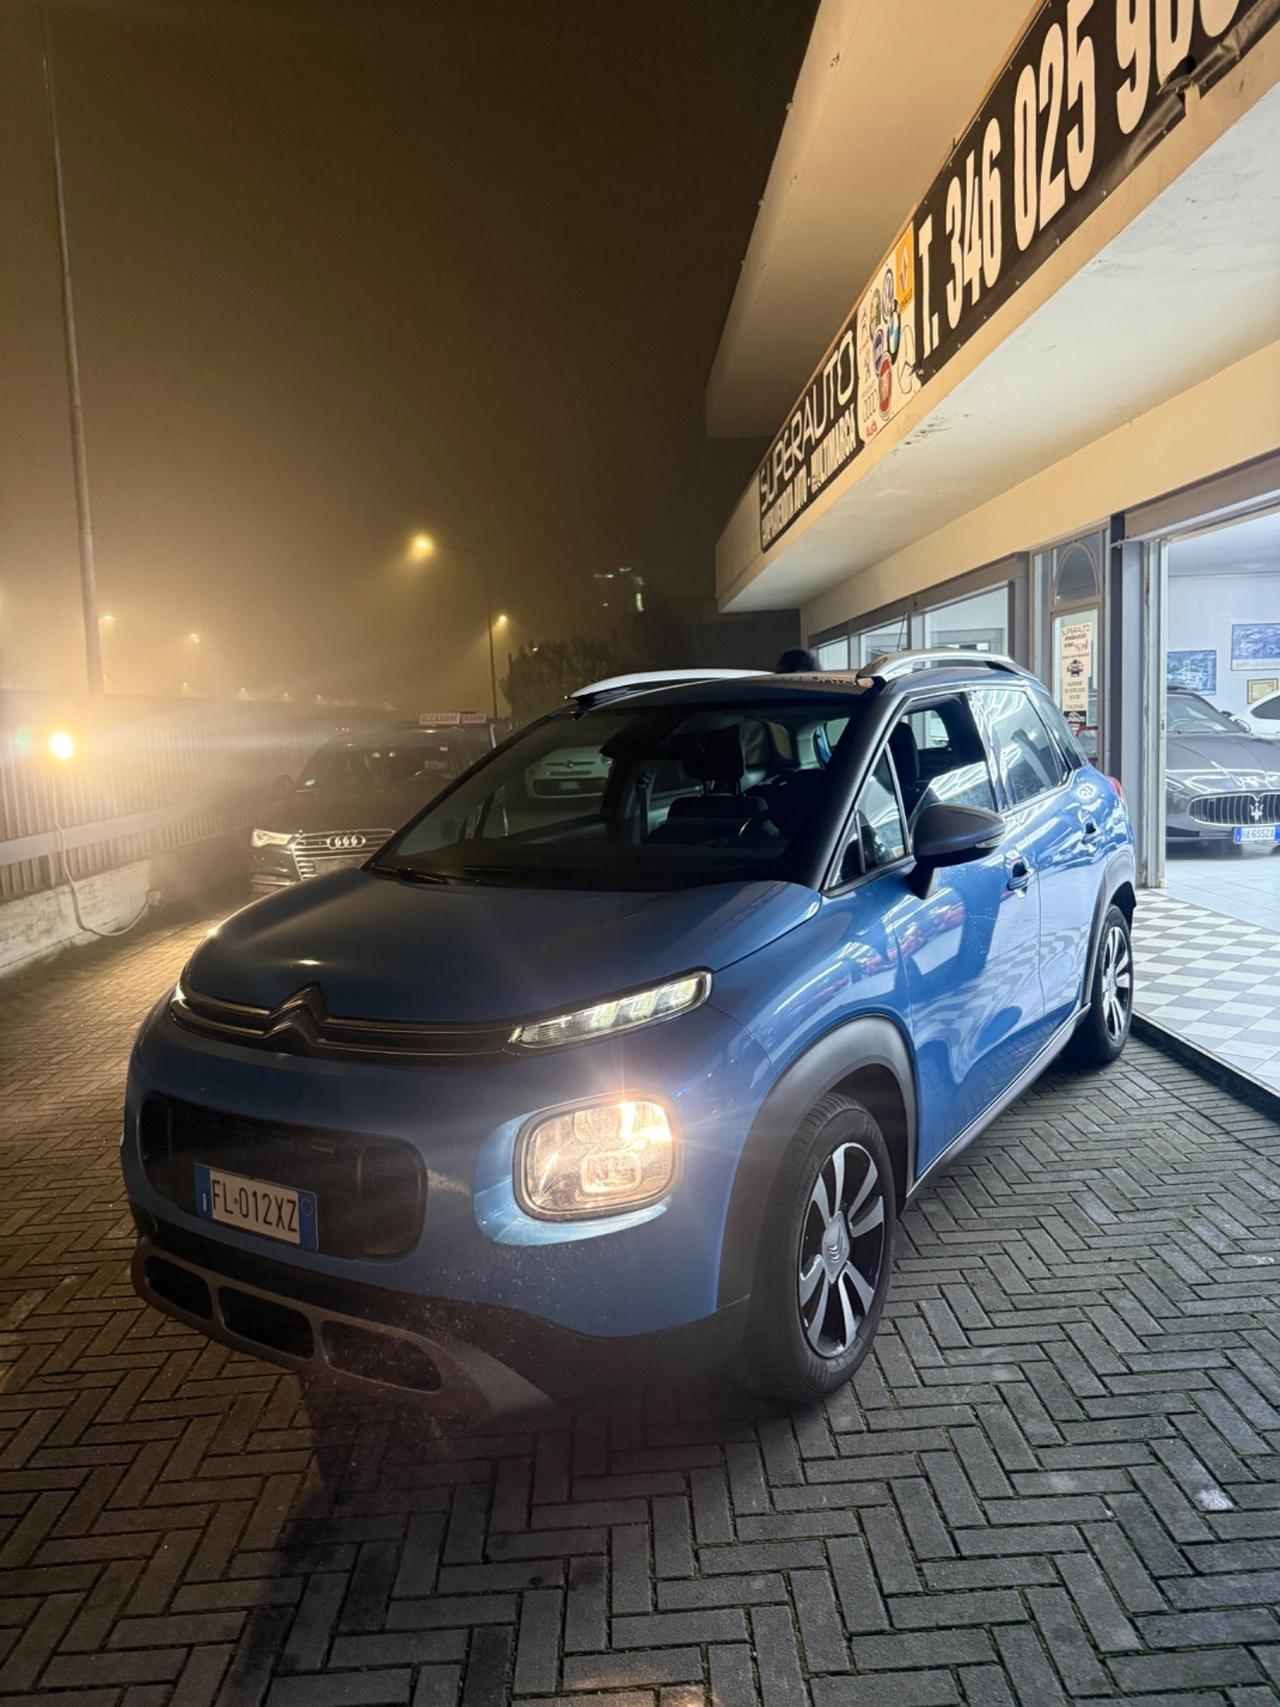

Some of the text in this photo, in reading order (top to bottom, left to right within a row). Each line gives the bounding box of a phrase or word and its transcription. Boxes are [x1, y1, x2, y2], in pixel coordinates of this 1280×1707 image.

[918, 0, 1096, 359] T. 346 025
[761, 330, 854, 513] SUPERAUTO
